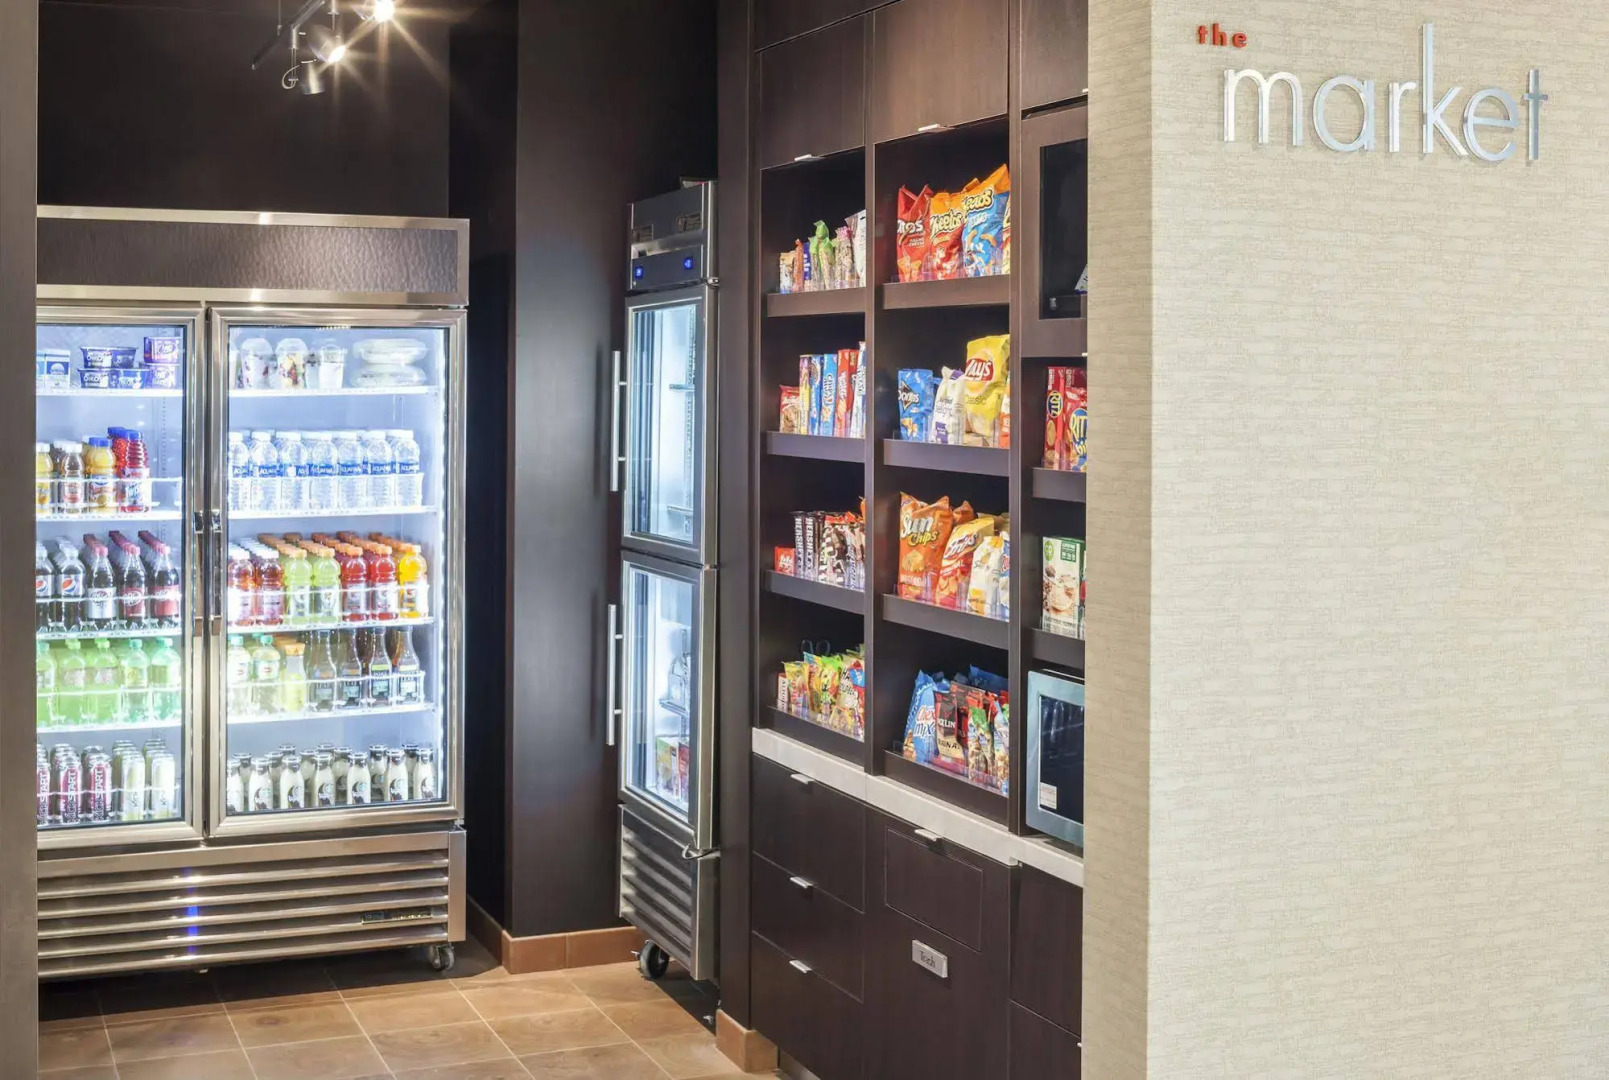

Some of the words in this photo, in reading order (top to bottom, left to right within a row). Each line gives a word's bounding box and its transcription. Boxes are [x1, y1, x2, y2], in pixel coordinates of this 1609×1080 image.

[1198, 23, 1247, 48] the
[1223, 23, 1548, 162] market
[901, 513, 934, 539] Sun
[907, 531, 938, 547] Chips
